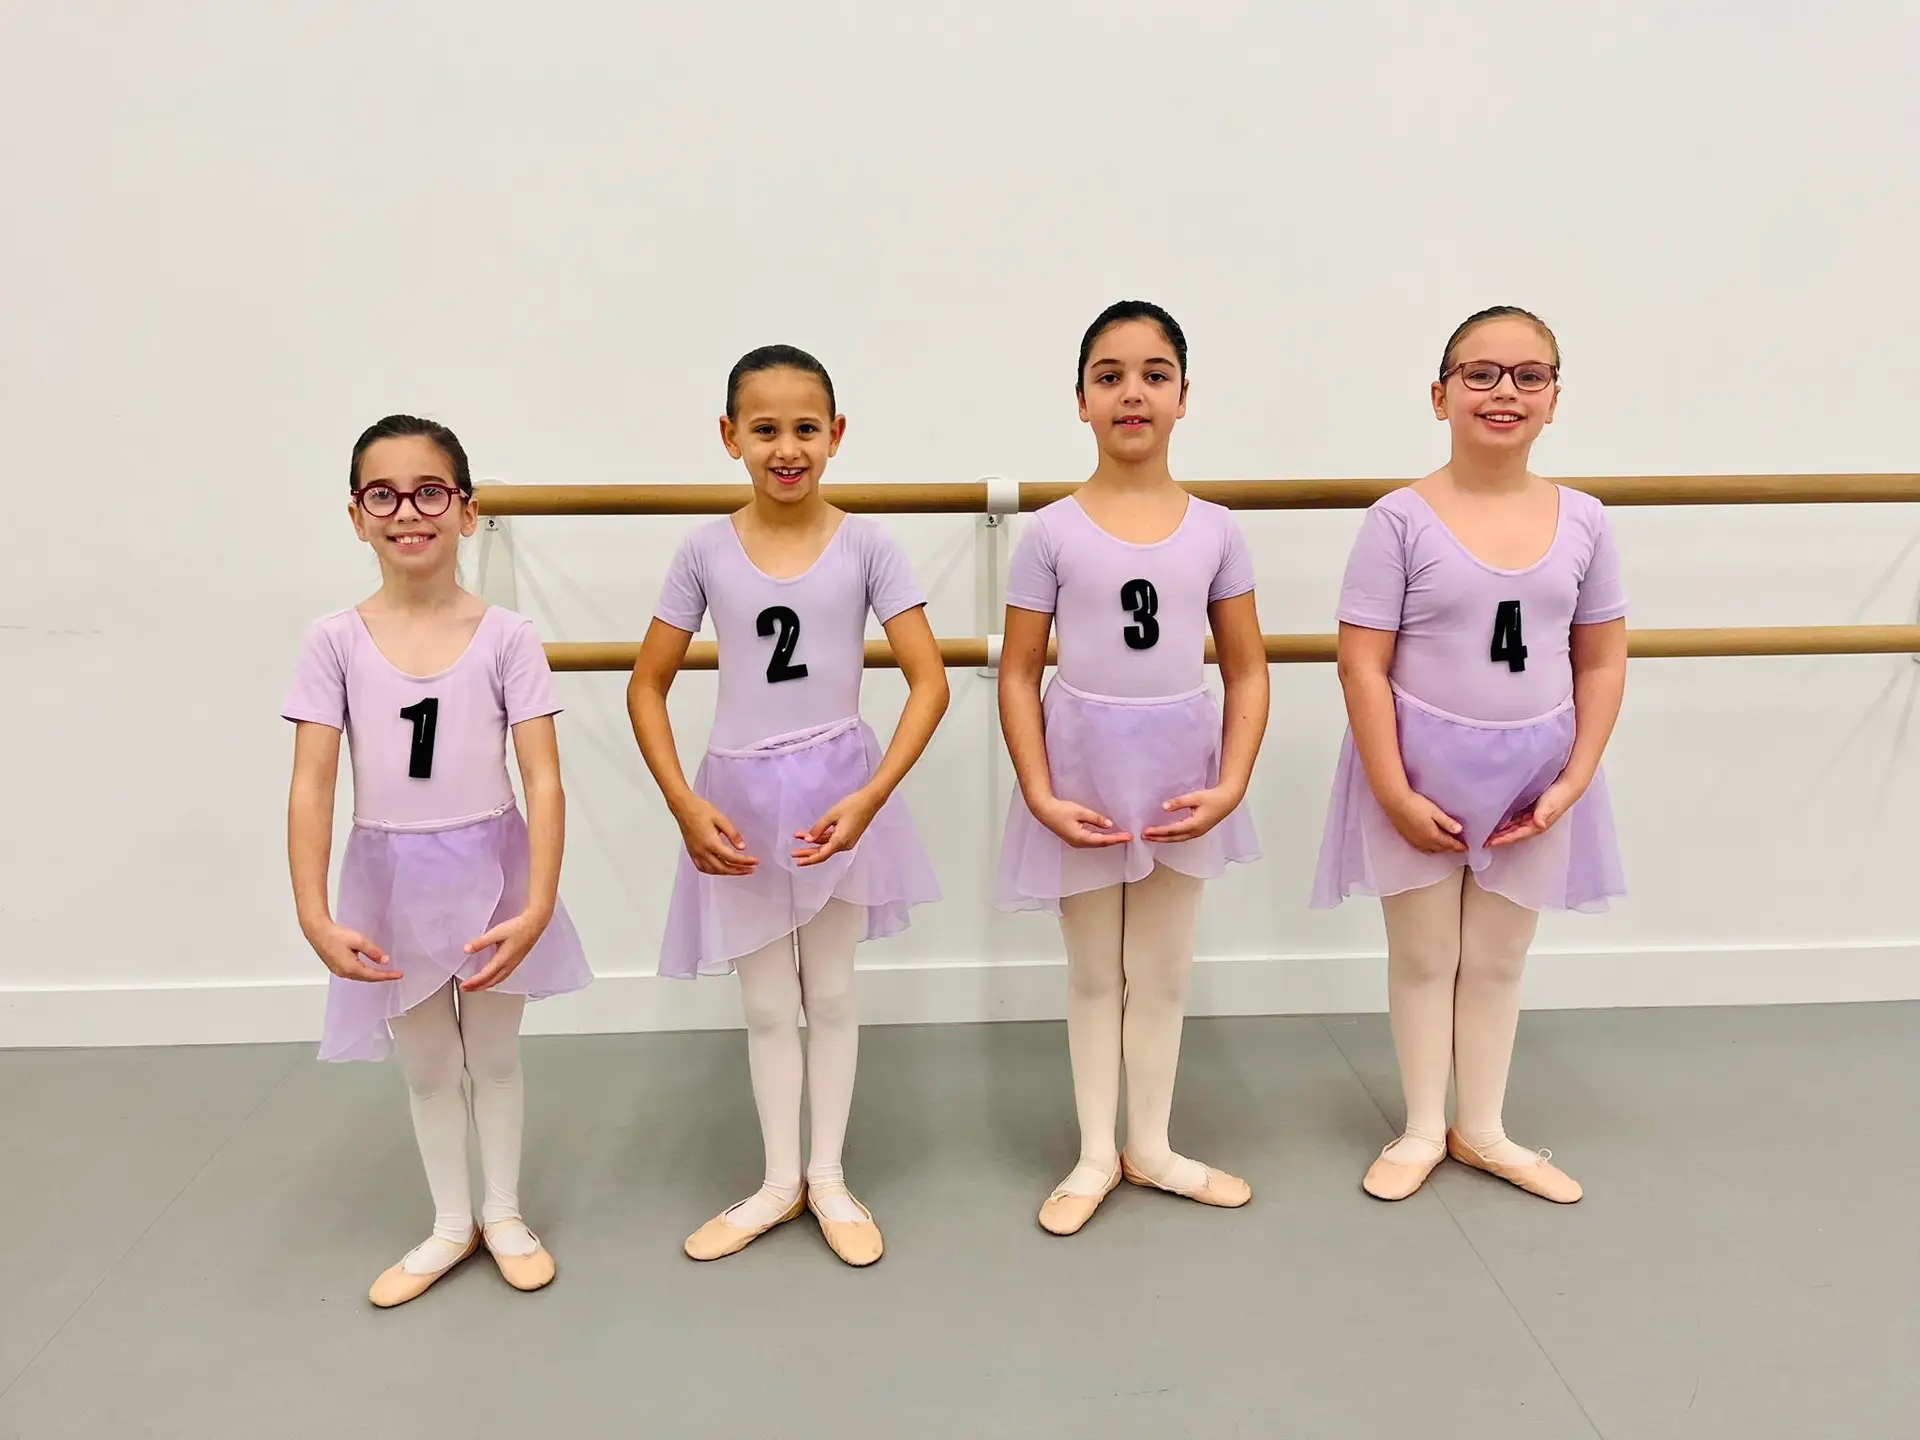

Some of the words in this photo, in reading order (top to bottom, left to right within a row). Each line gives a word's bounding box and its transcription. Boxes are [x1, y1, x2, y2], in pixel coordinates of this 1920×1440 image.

[755, 605, 809, 684] 2
[1120, 578, 1160, 651] 3
[1489, 599, 1528, 673] 4
[400, 697, 439, 779] 1
